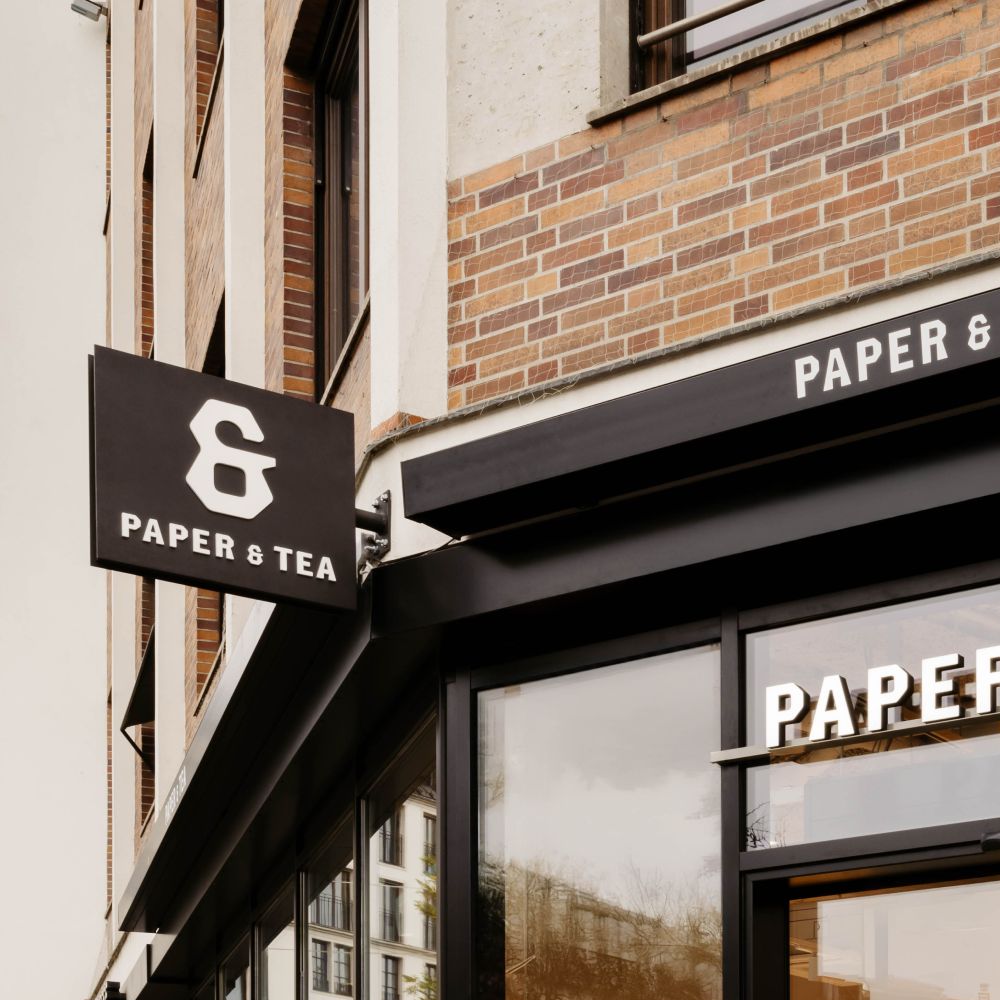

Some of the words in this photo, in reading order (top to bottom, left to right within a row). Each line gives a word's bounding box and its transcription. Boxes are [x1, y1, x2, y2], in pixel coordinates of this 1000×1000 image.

[794, 319, 949, 399] PAPER
[967, 313, 991, 351] &
[185, 398, 276, 519] &
[121, 512, 235, 560] PAPER
[246, 544, 264, 566] &
[273, 545, 337, 582] TEA
